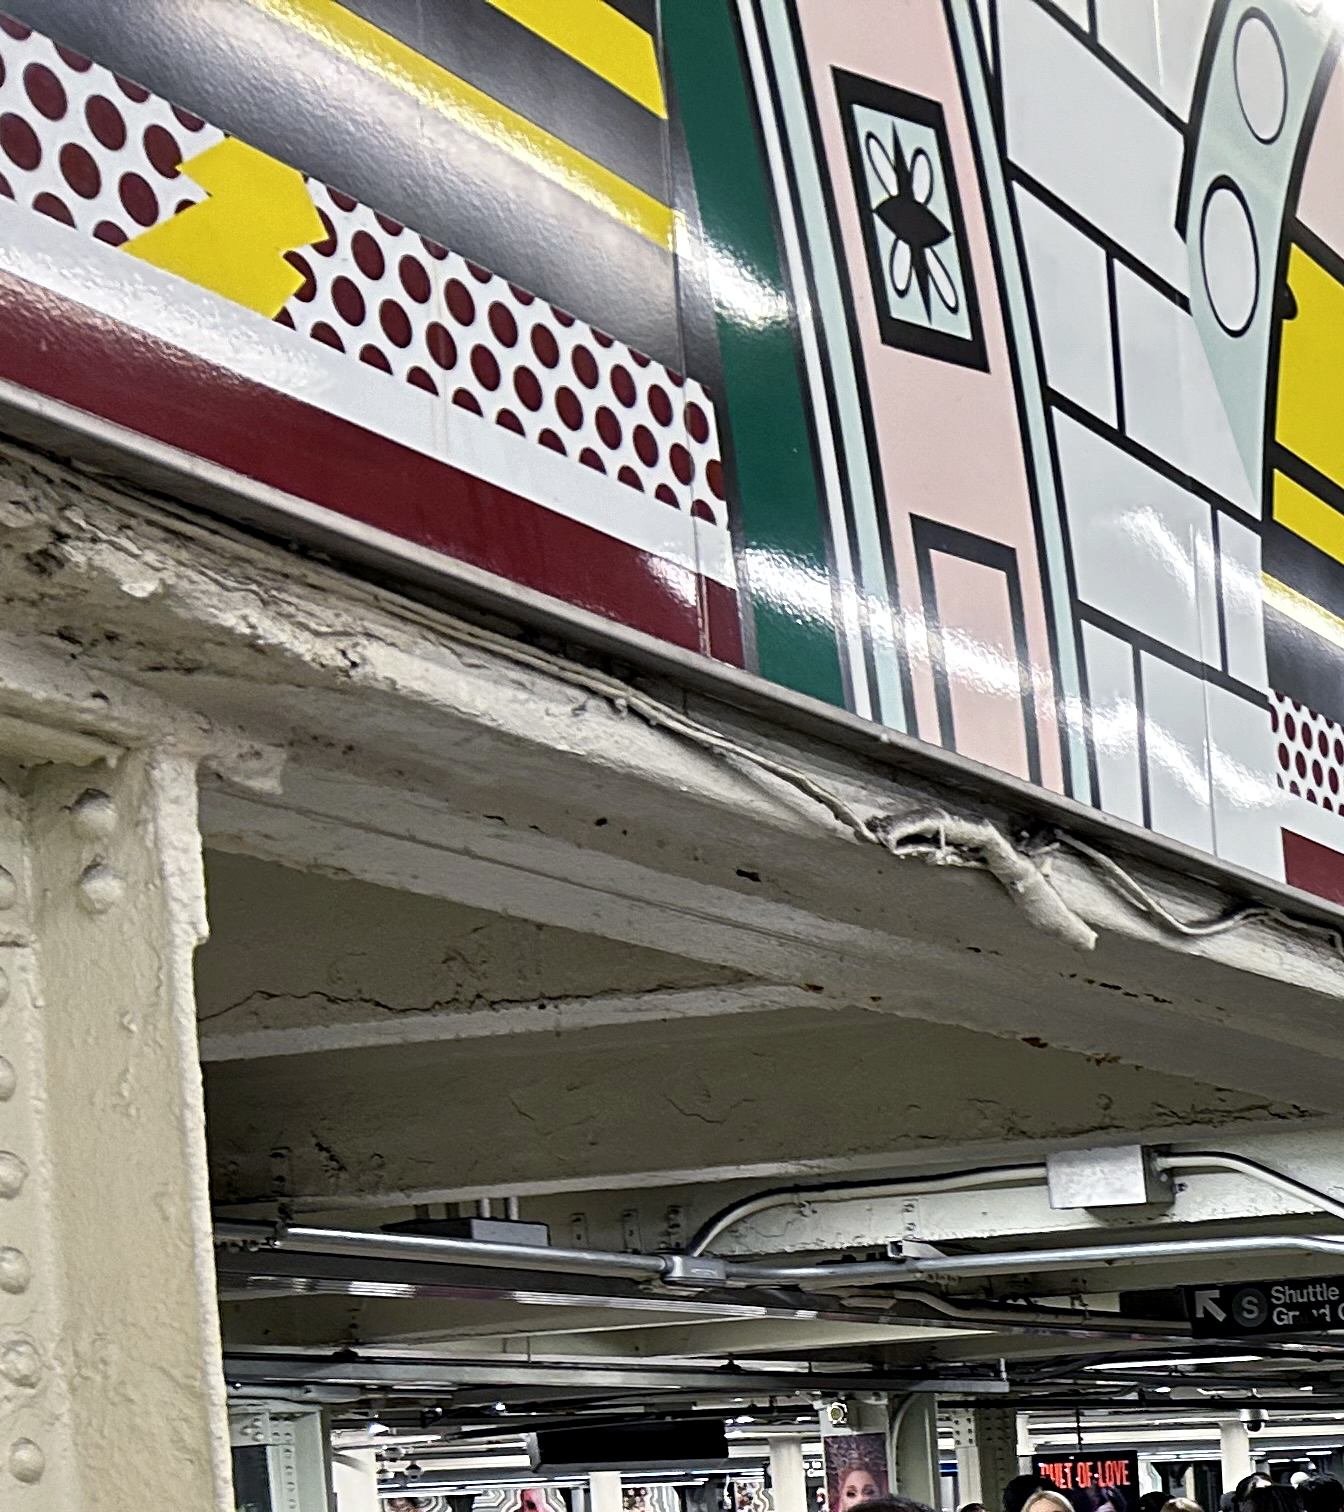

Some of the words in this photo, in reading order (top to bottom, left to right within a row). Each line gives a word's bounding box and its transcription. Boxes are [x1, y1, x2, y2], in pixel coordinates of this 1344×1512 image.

[1271, 1283, 1340, 1305] Shuttle
[1242, 1296, 1260, 1319] S
[1076, 1461, 1094, 1489] OF
[1097, 1459, 1131, 1487] LOVE
